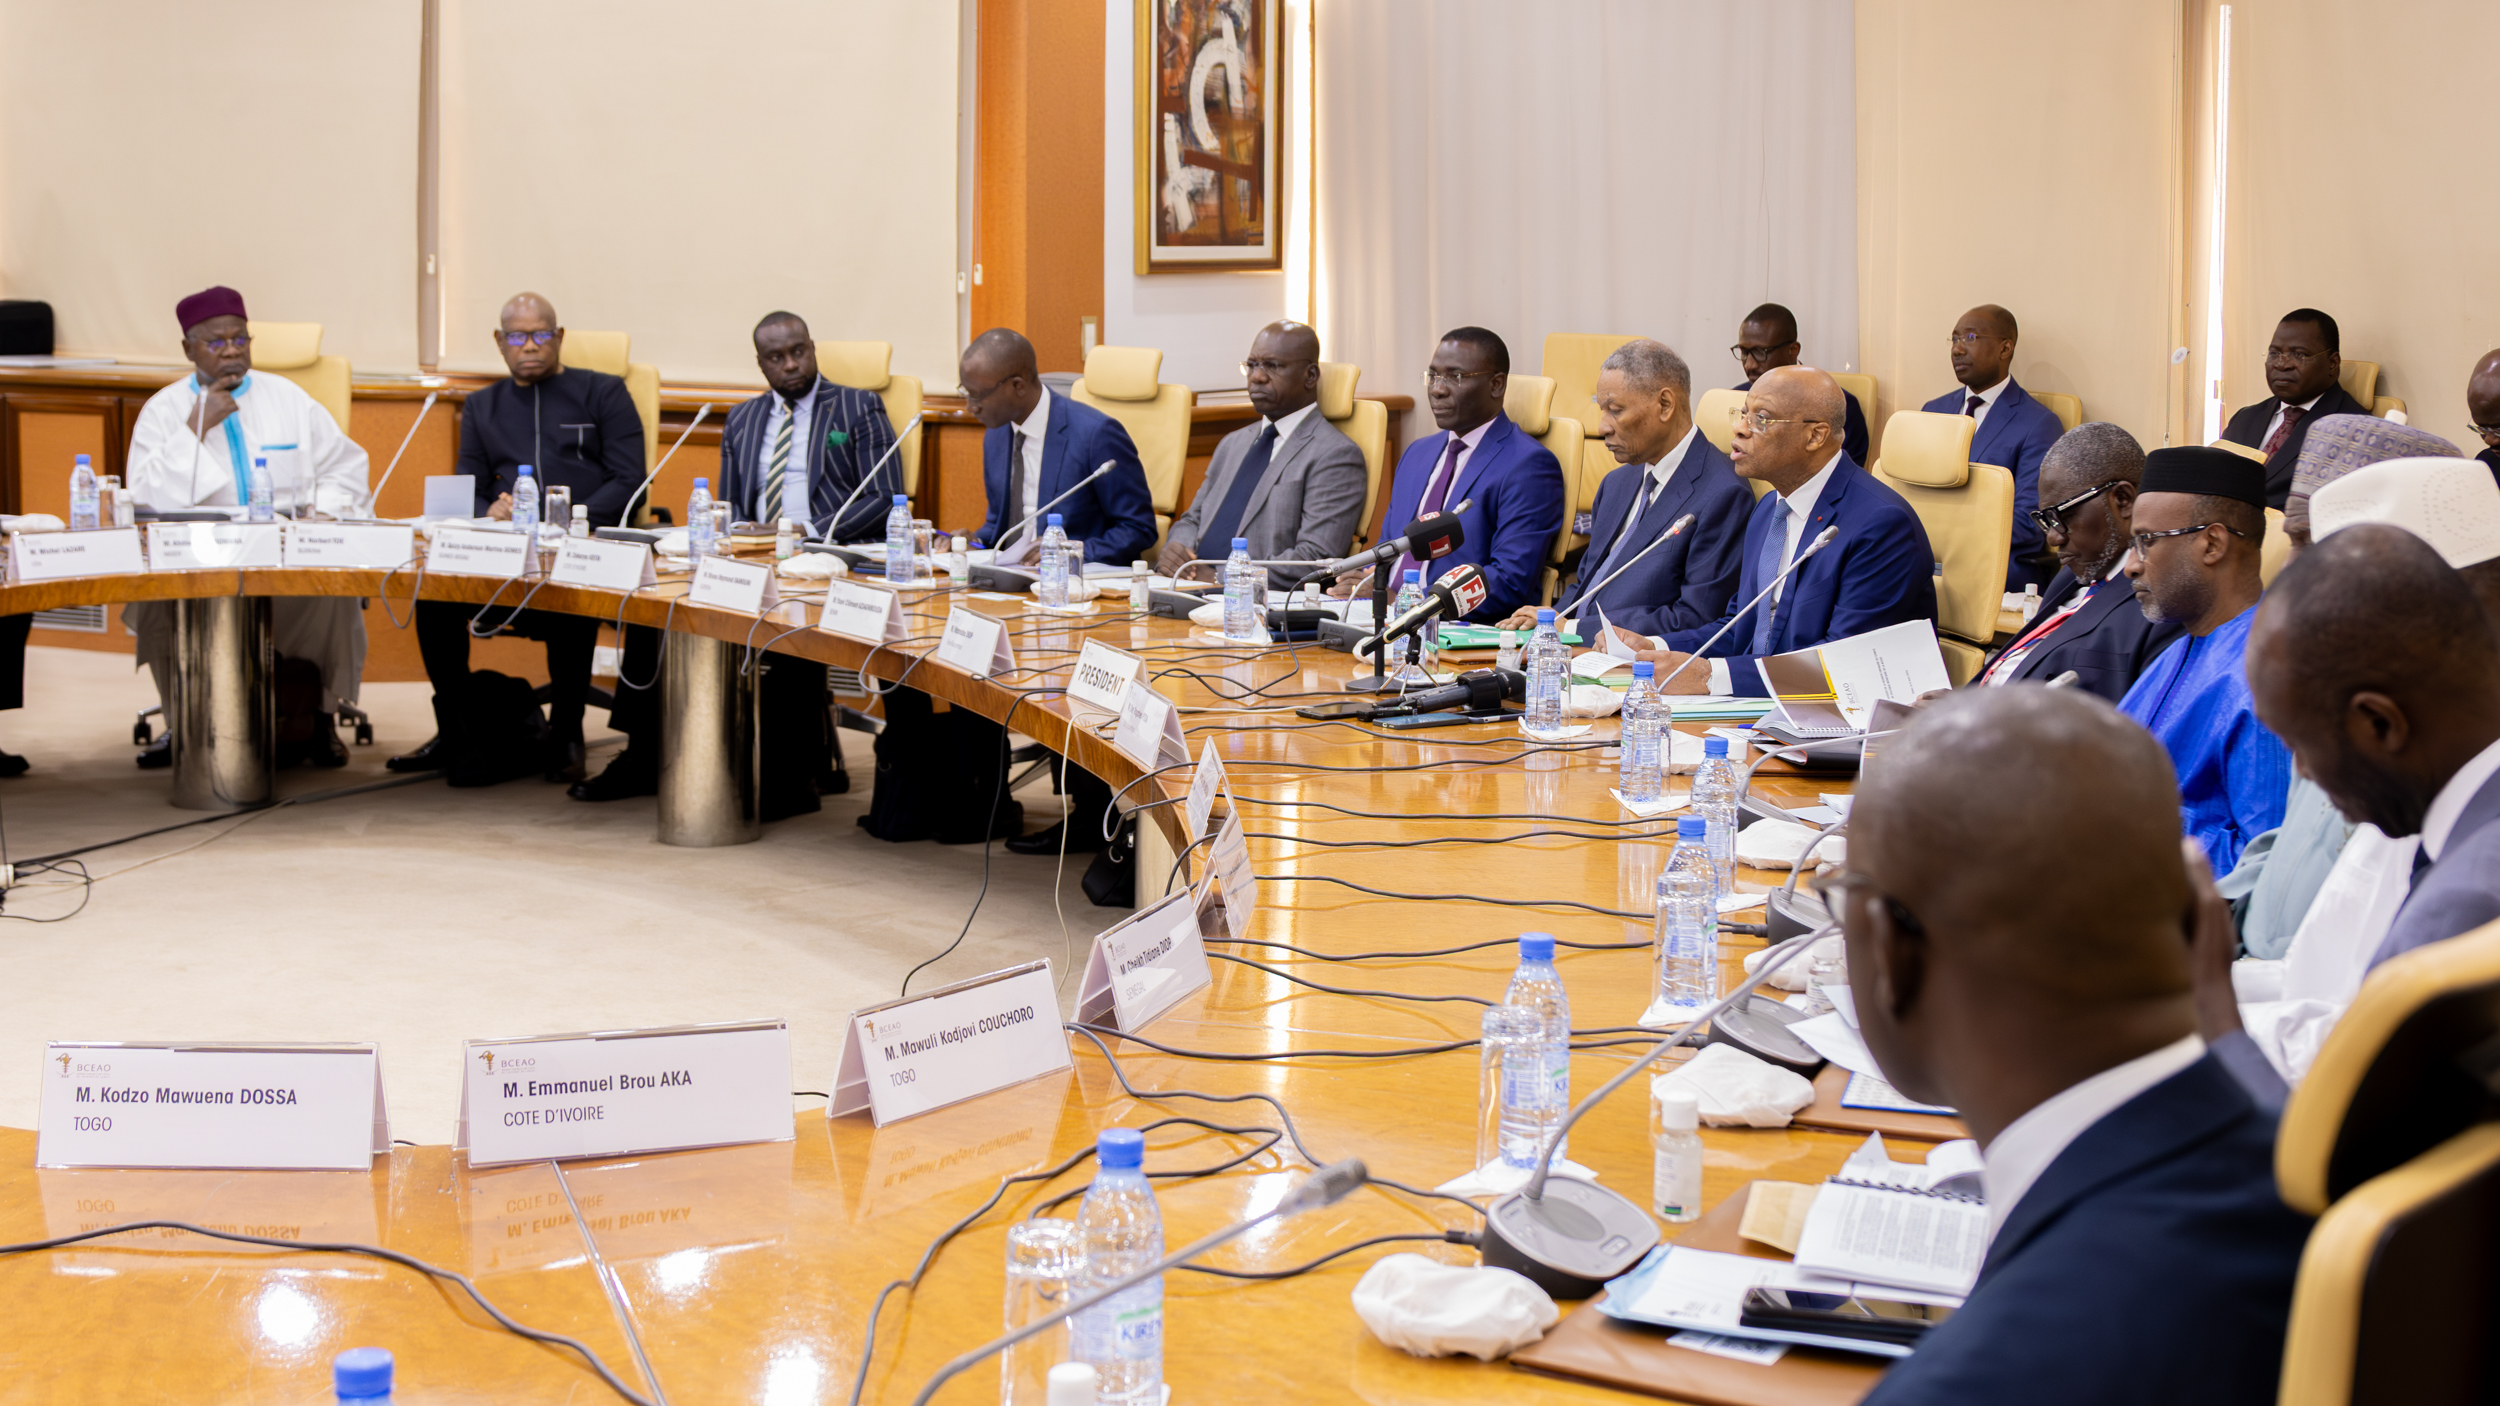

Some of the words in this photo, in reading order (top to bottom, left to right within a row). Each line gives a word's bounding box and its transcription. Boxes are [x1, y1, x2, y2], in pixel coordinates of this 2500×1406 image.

[1462, 576, 1485, 612] FA
[1078, 663, 1125, 696] PRESIDENT
[1843, 682, 1856, 704] BCEAO
[1127, 953, 1144, 972] Cheikh
[1142, 946, 1161, 964] Tidiane
[1159, 936, 1172, 954] DIOP
[878, 1021, 902, 1034] BCEAO
[884, 1045, 899, 1061] M.
[900, 1033, 938, 1057] Mawuli
[939, 1022, 977, 1045] Kodjovi
[978, 1005, 1034, 1034] COUCHORO
[76, 1063, 111, 1073] BCEAO
[501, 1058, 536, 1068] BCEAO
[503, 1082, 523, 1098] M.
[528, 1075, 613, 1097] Emmanuel
[620, 1074, 655, 1090] Brou
[660, 1070, 692, 1087] AKA
[890, 1068, 916, 1087] TOGO
[75, 1086, 95, 1103] M.
[100, 1086, 149, 1104] Kodzo
[156, 1087, 234, 1105] Mawuena
[240, 1088, 297, 1105] DOSSA
[74, 1116, 112, 1132] TOGO
[504, 1110, 540, 1126] COTE
[545, 1105, 604, 1124] D'IVOIRE
